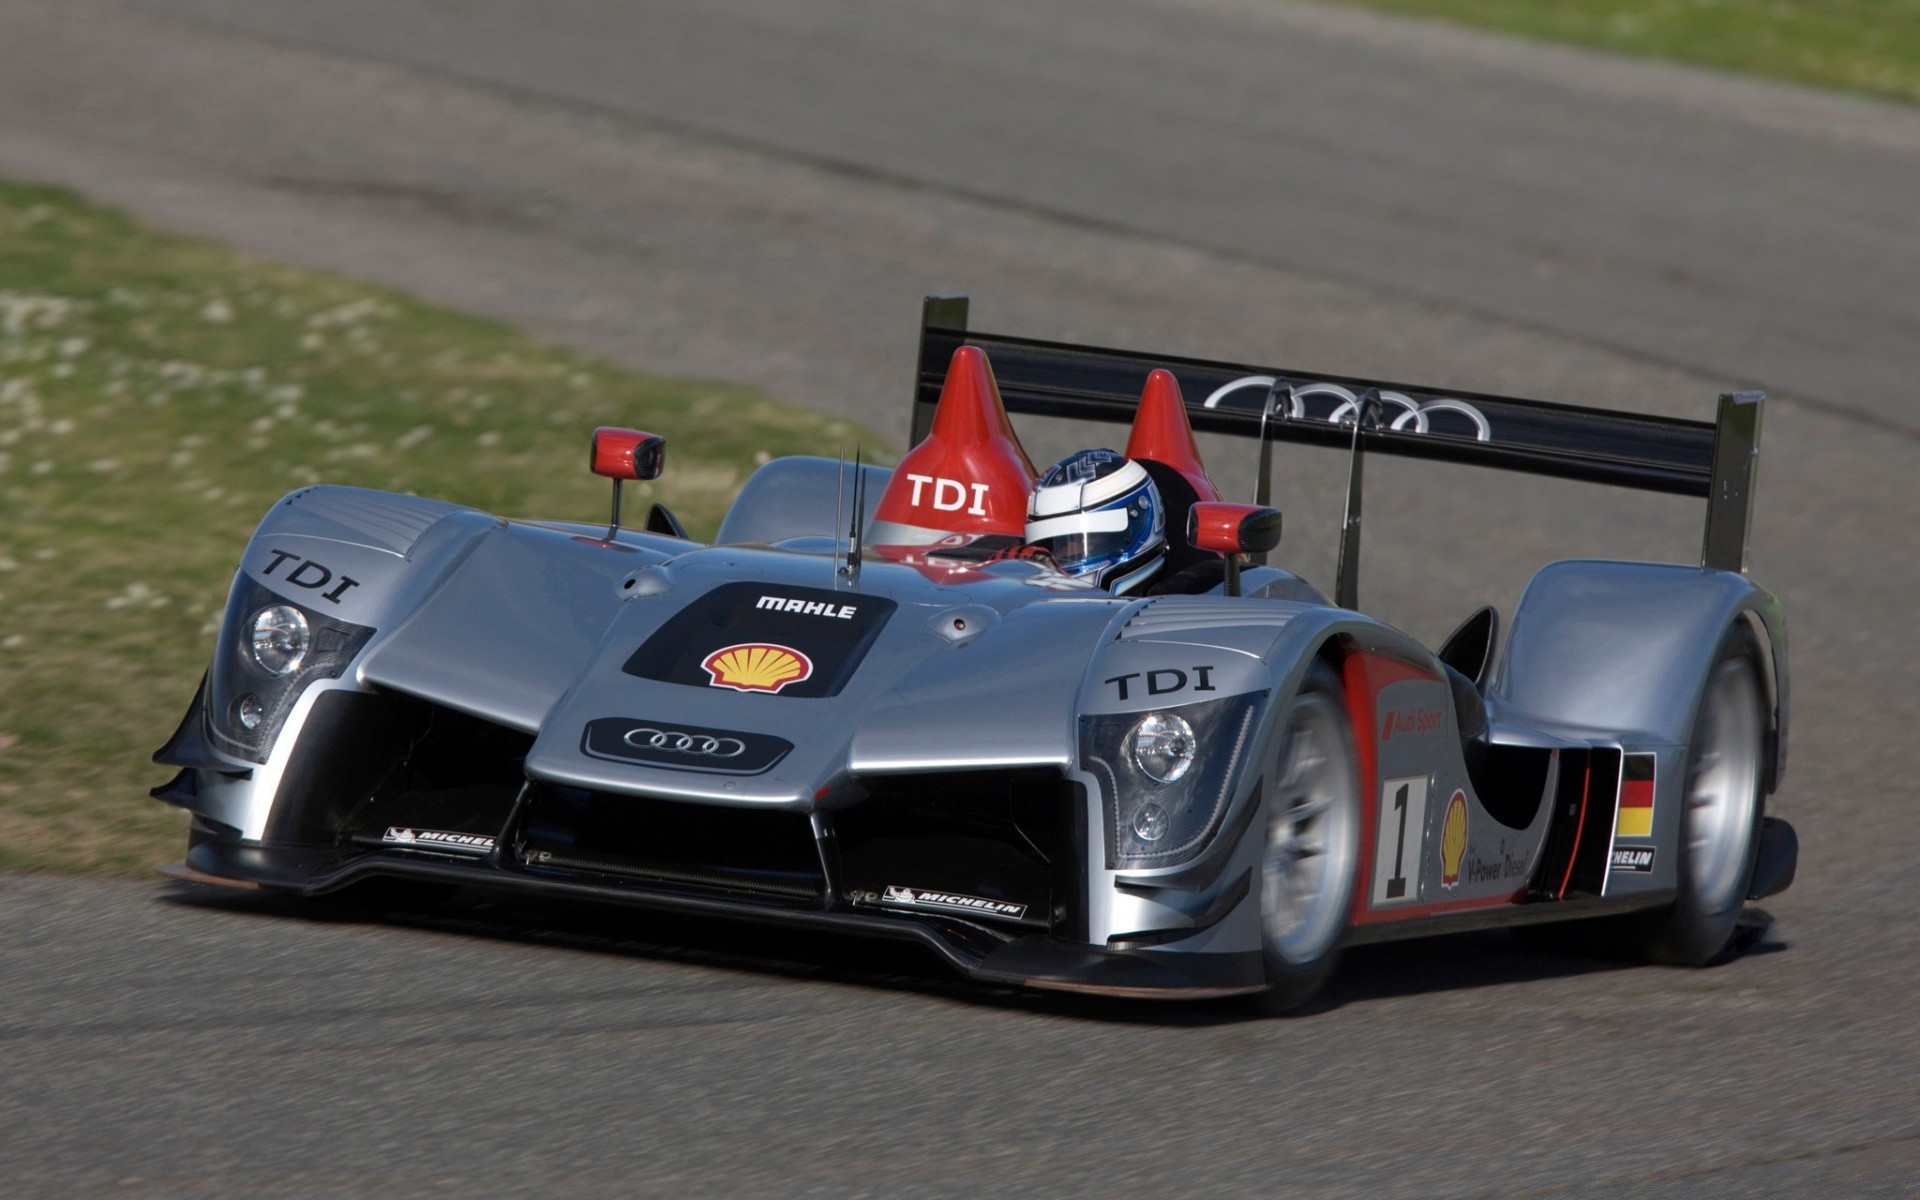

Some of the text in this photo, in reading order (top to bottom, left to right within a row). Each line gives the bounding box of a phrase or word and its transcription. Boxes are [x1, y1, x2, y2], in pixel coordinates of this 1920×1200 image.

[907, 473, 989, 516] TDI
[262, 549, 360, 604] TDI
[756, 596, 857, 619] MAHLE
[1105, 666, 1216, 700] TDI
[1394, 708, 1442, 732] Audi Sport
[1386, 783, 1409, 898] 1
[1467, 858, 1501, 882] V-Power
[918, 892, 1021, 913] MICHELIN
